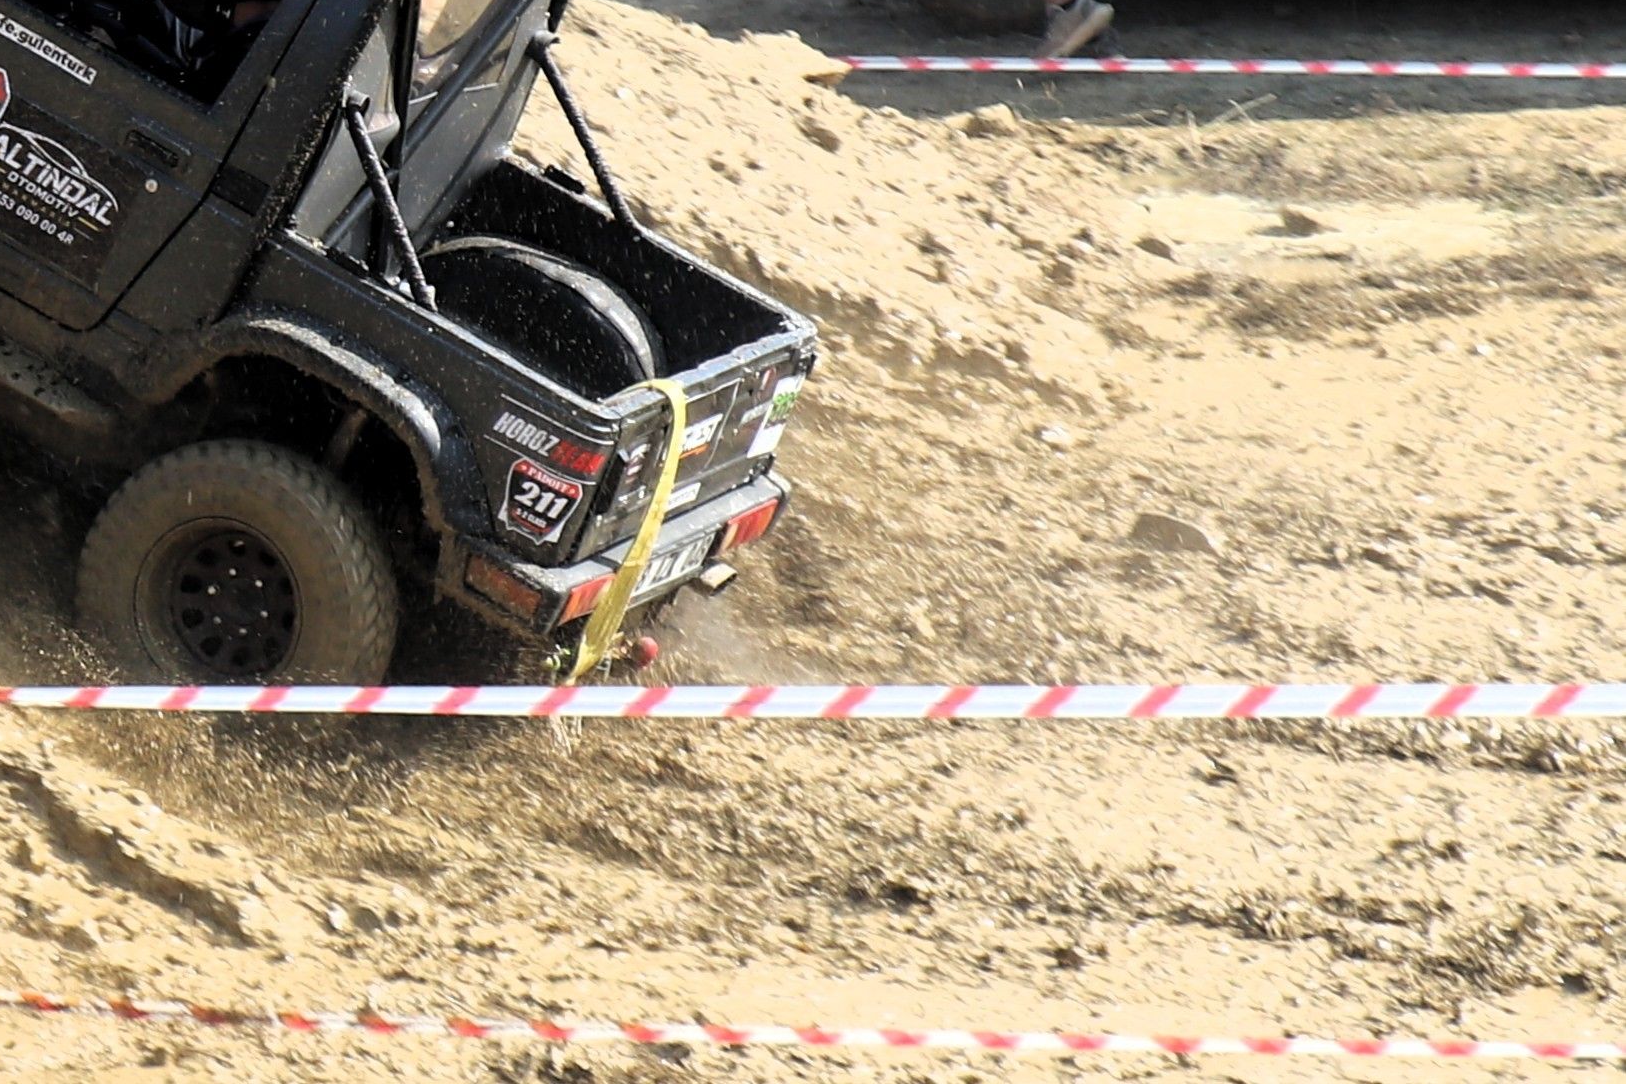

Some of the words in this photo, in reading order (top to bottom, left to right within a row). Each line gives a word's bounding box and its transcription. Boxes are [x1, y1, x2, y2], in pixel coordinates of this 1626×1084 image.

[15, 204, 40, 225] 090
[39, 219, 57, 235] 00
[514, 481, 569, 519] 211
